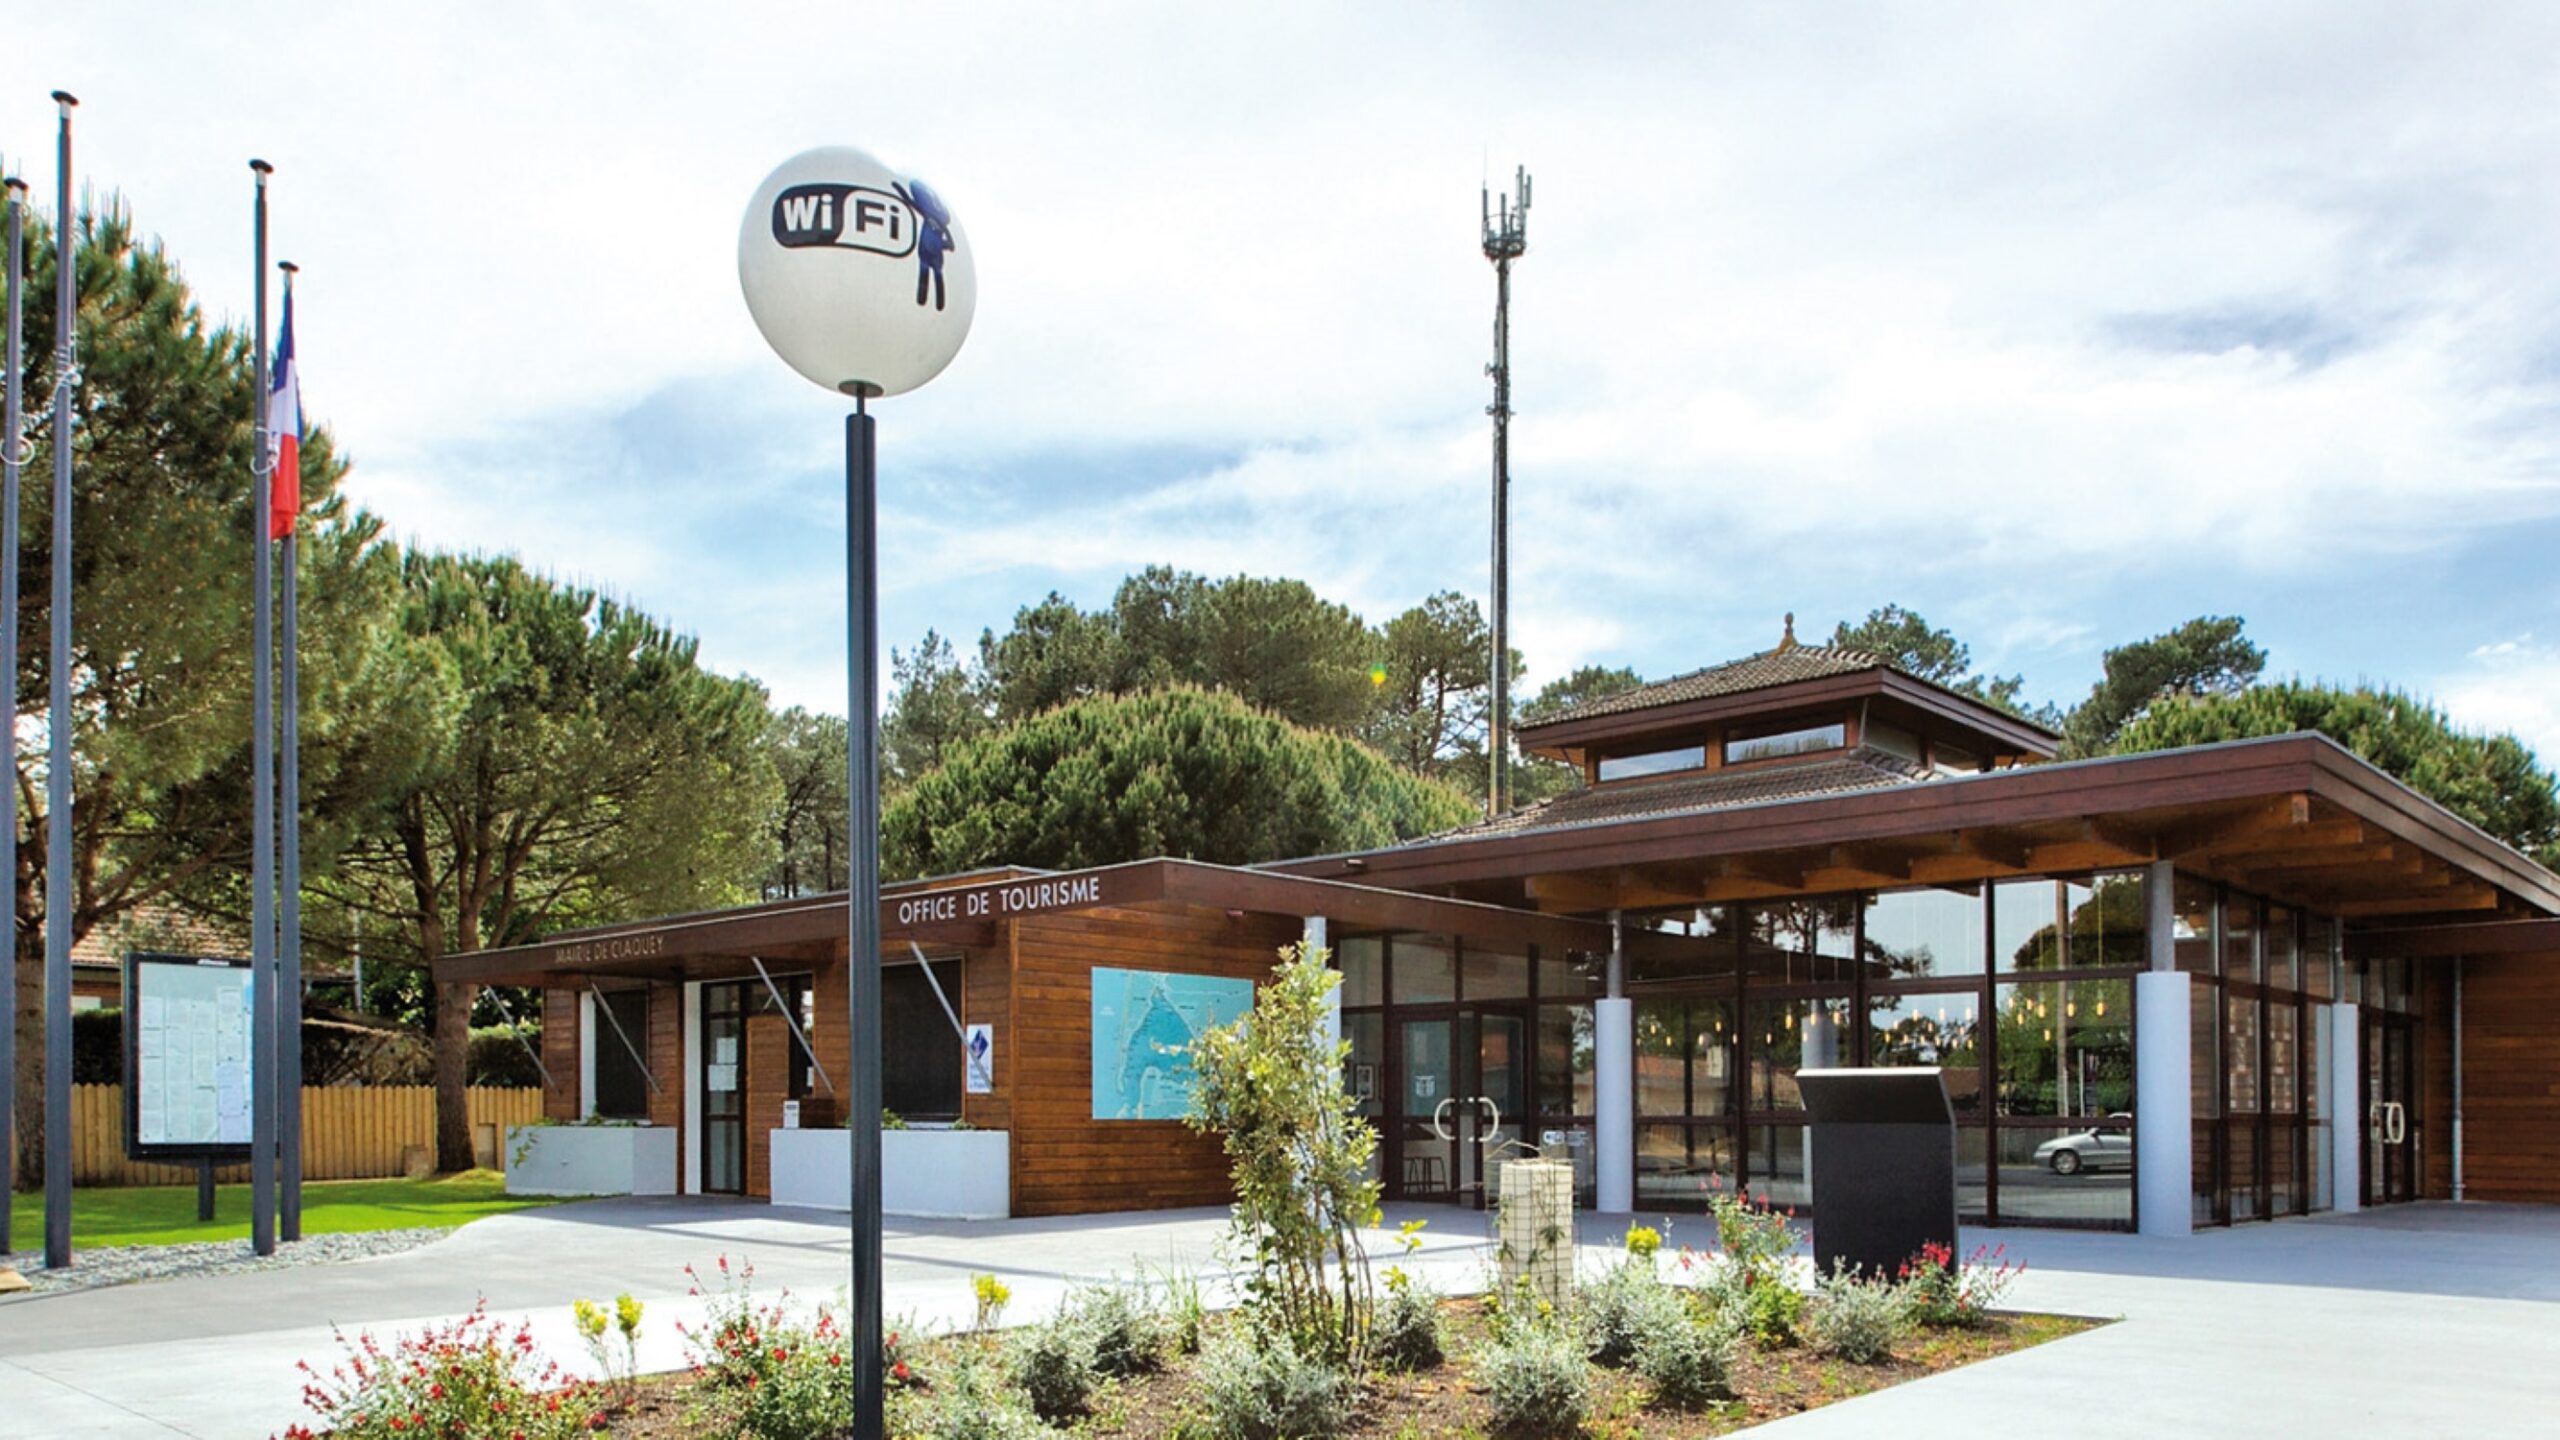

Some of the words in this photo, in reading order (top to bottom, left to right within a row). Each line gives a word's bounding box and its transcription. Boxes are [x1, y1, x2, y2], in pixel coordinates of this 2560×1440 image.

[782, 193, 833, 233] Wi
[855, 198, 900, 241] Fi
[899, 896, 957, 924] OFFICE
[967, 892, 989, 916] DE
[1000, 876, 1100, 912] TOURISME
